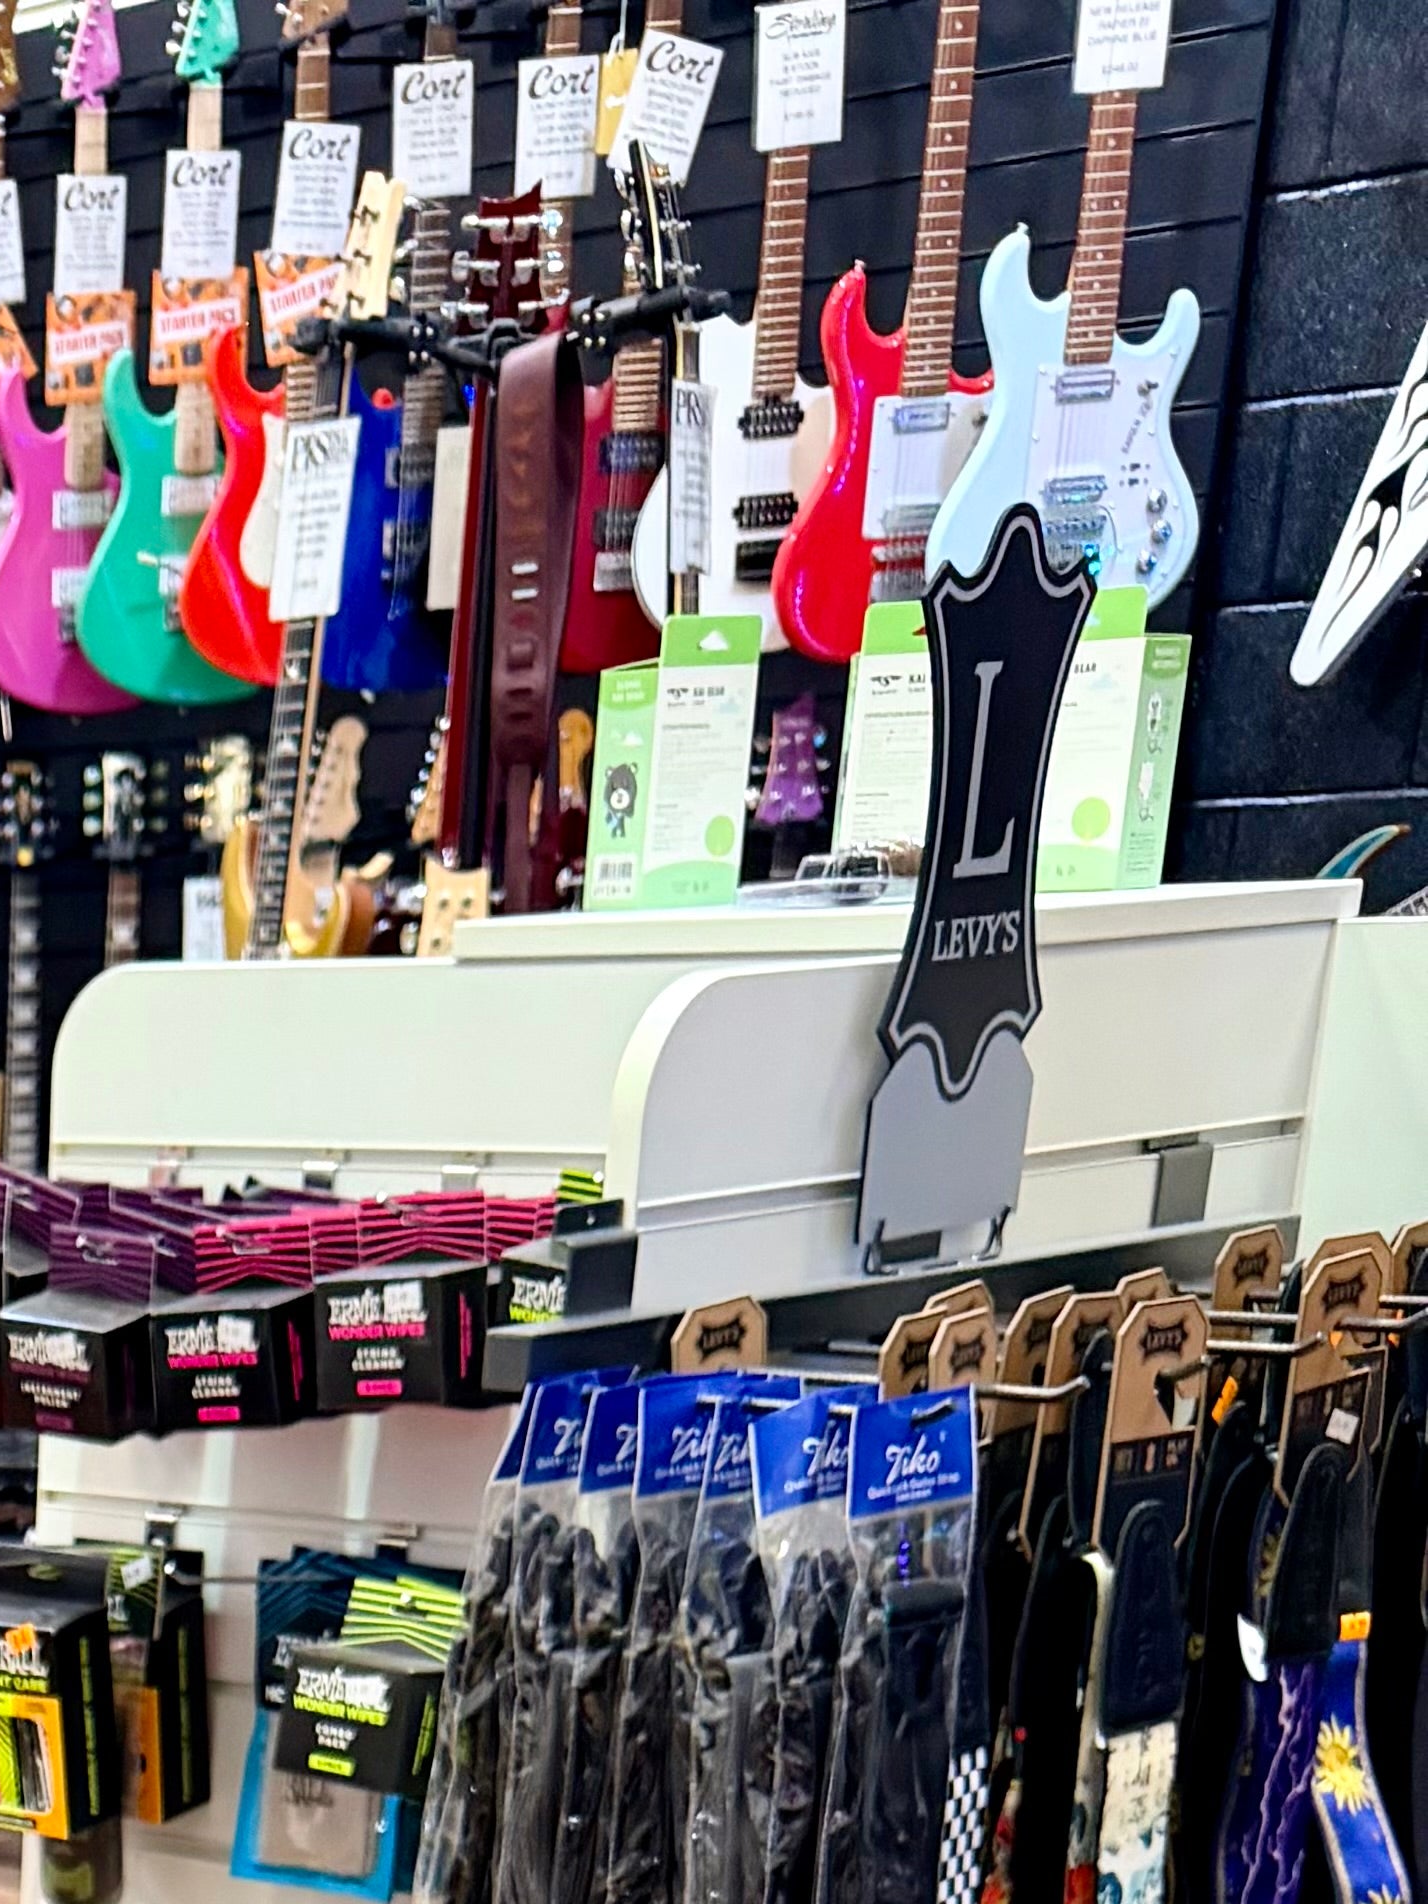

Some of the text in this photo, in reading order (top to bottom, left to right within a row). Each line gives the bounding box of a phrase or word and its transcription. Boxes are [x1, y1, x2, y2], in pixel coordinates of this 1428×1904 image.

[646, 40, 715, 84] Cort
[400, 69, 468, 105] Cort
[528, 64, 596, 99] Cort
[289, 129, 352, 162] Cort
[172, 156, 233, 192] Cort
[63, 178, 121, 212] Cort
[952, 660, 1015, 879] L
[930, 910, 1021, 963] LEVY'S
[328, 1286, 382, 1327] ERNIE
[164, 1317, 215, 1357] ERNIE
[328, 1324, 384, 1342] WONDER
[885, 1432, 942, 1487] Tiko
[295, 1666, 345, 1704] ERNIE
